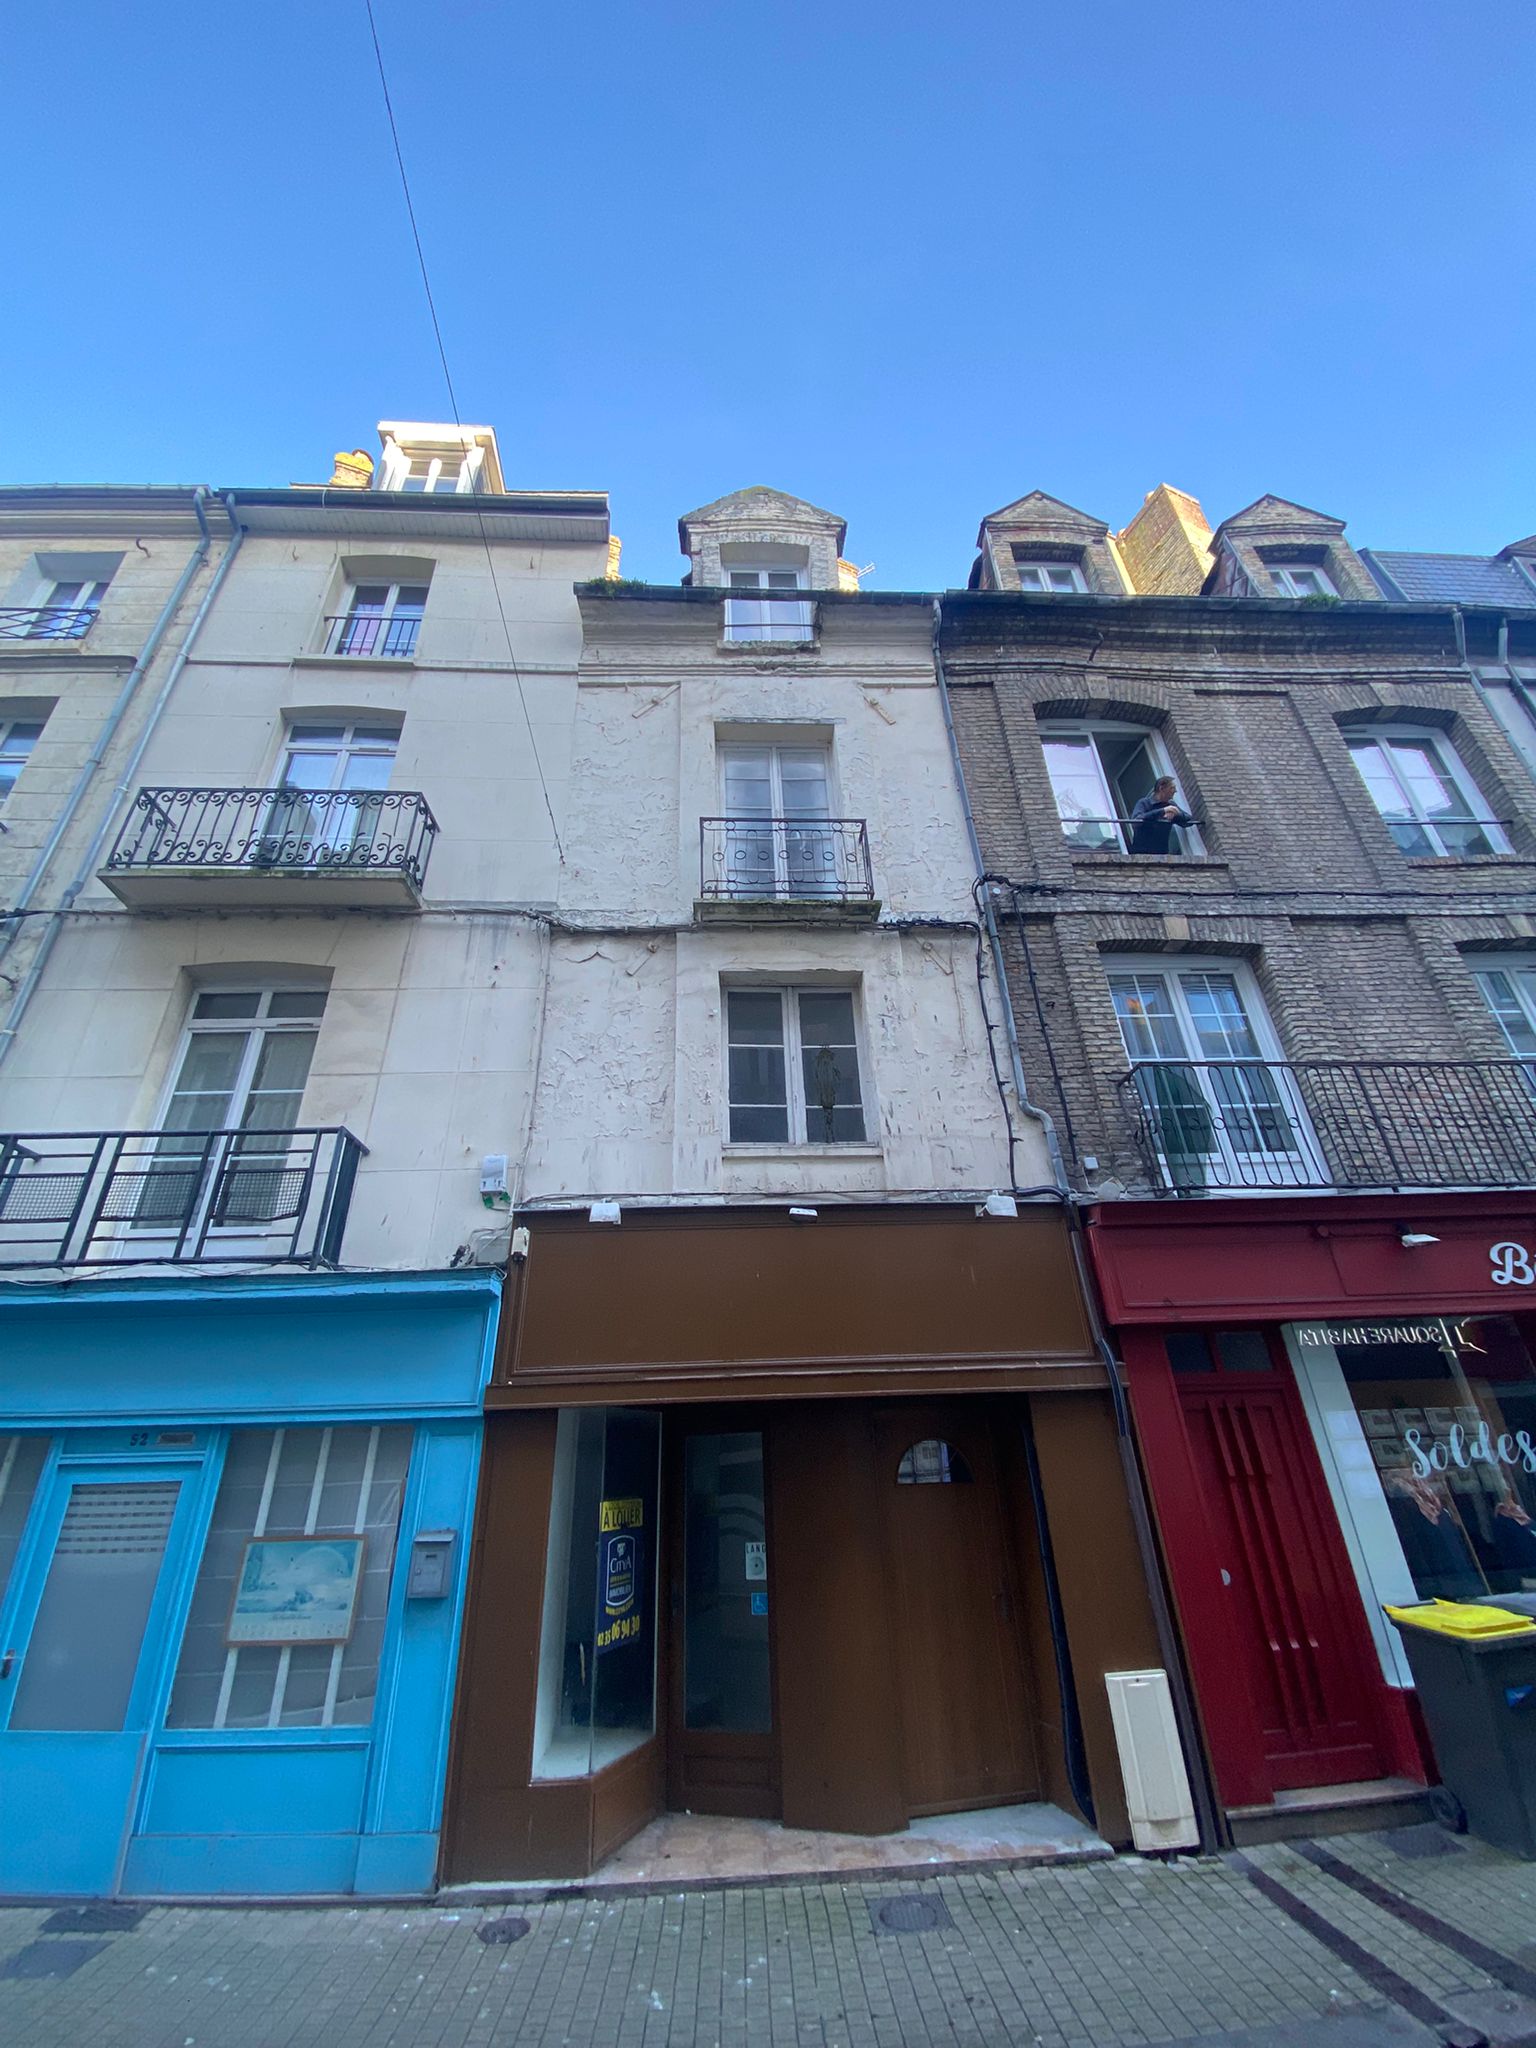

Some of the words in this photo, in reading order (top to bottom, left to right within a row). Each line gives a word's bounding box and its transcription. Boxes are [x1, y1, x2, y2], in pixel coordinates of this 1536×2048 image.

[1490, 1241, 1536, 1285] B
[1405, 1421, 1536, 1478] Soldes
[612, 1507, 641, 1528] LOUER
[611, 1619, 621, 1641] 06
[631, 1615, 640, 1636] 30
